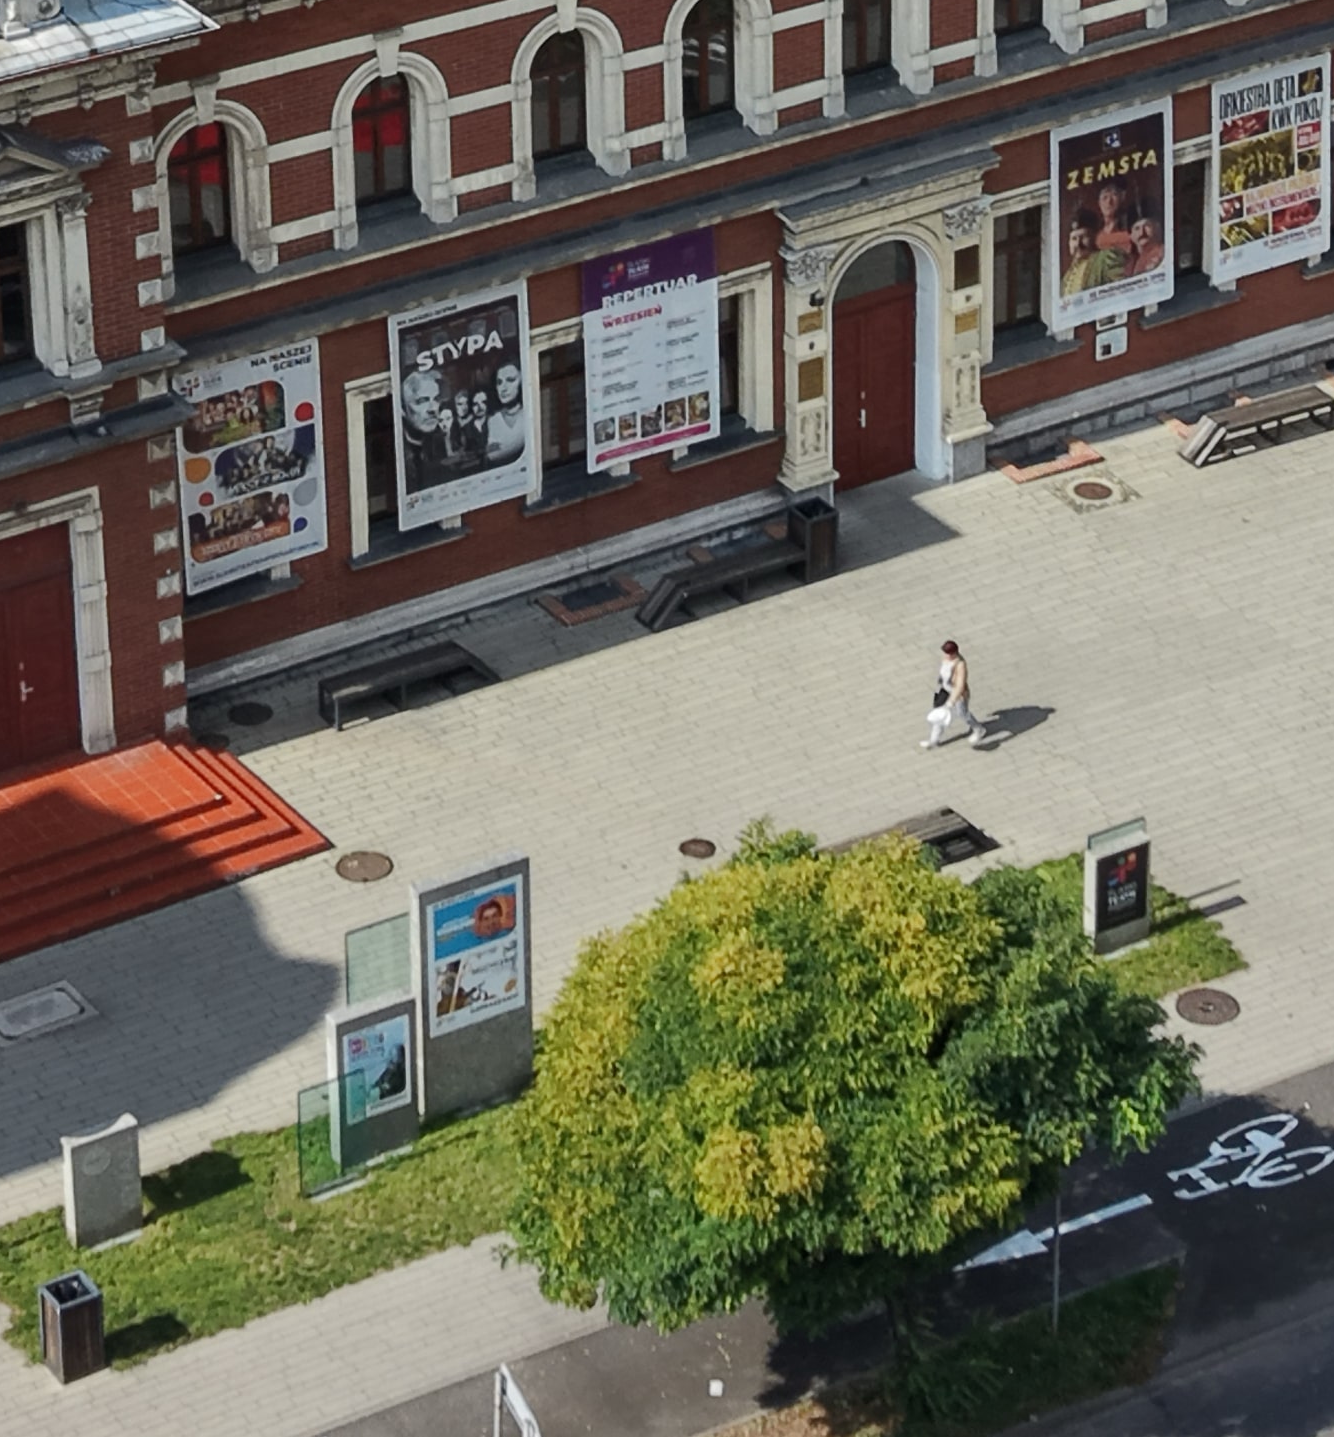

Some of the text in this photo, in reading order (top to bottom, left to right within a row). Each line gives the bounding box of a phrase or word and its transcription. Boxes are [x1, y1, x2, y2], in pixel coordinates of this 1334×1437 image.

[1219, 81, 1271, 120] ORKIESTRA
[1066, 148, 1158, 191] ZEMSTA
[602, 273, 698, 309] REPERTUAR
[250, 344, 312, 368] NA NASZEJ
[273, 354, 312, 372] SCENIE
[415, 329, 504, 372] STYPA
